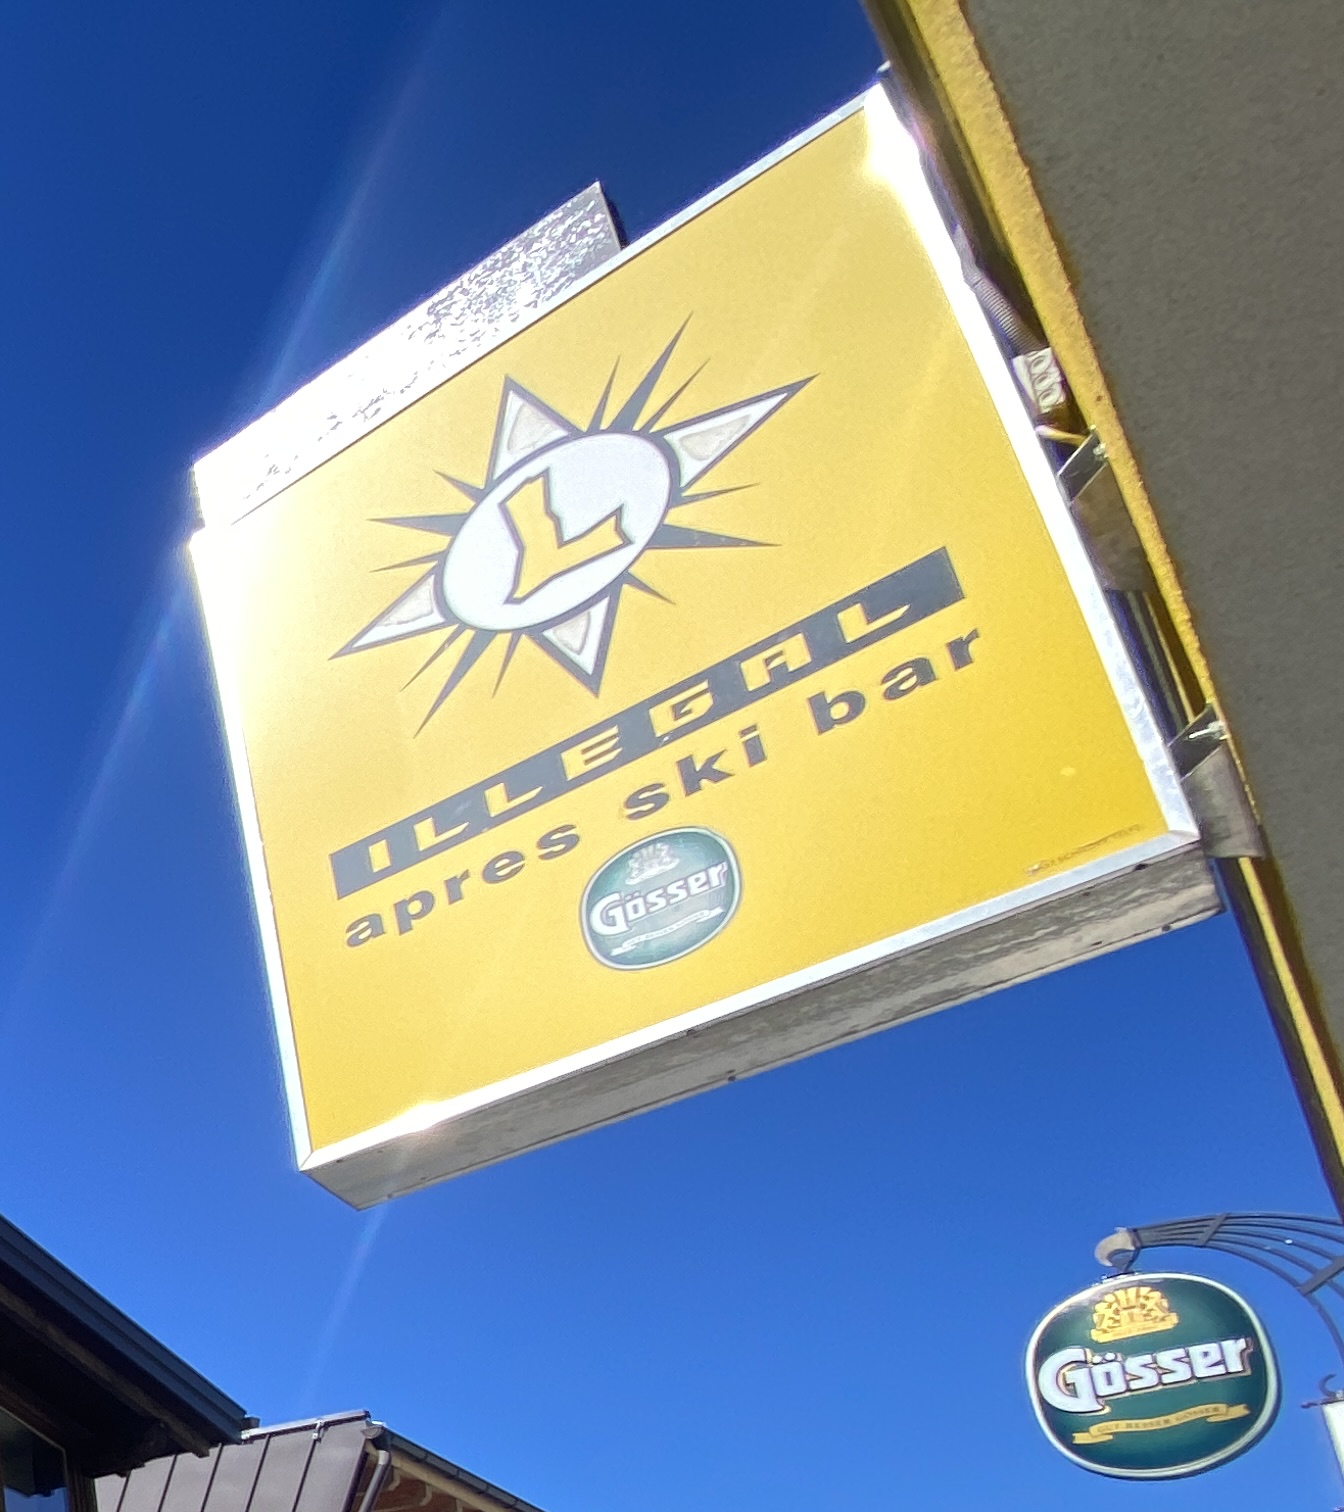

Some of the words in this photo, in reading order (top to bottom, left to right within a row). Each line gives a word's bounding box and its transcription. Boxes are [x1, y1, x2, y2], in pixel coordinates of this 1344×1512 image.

[497, 466, 635, 605] L
[344, 822, 581, 949] apres
[623, 725, 768, 821] ski
[807, 627, 982, 736] bar
[367, 598, 913, 877] ILLEGAL
[589, 861, 729, 936] Gösser
[1037, 1338, 1252, 1414] Gösser
